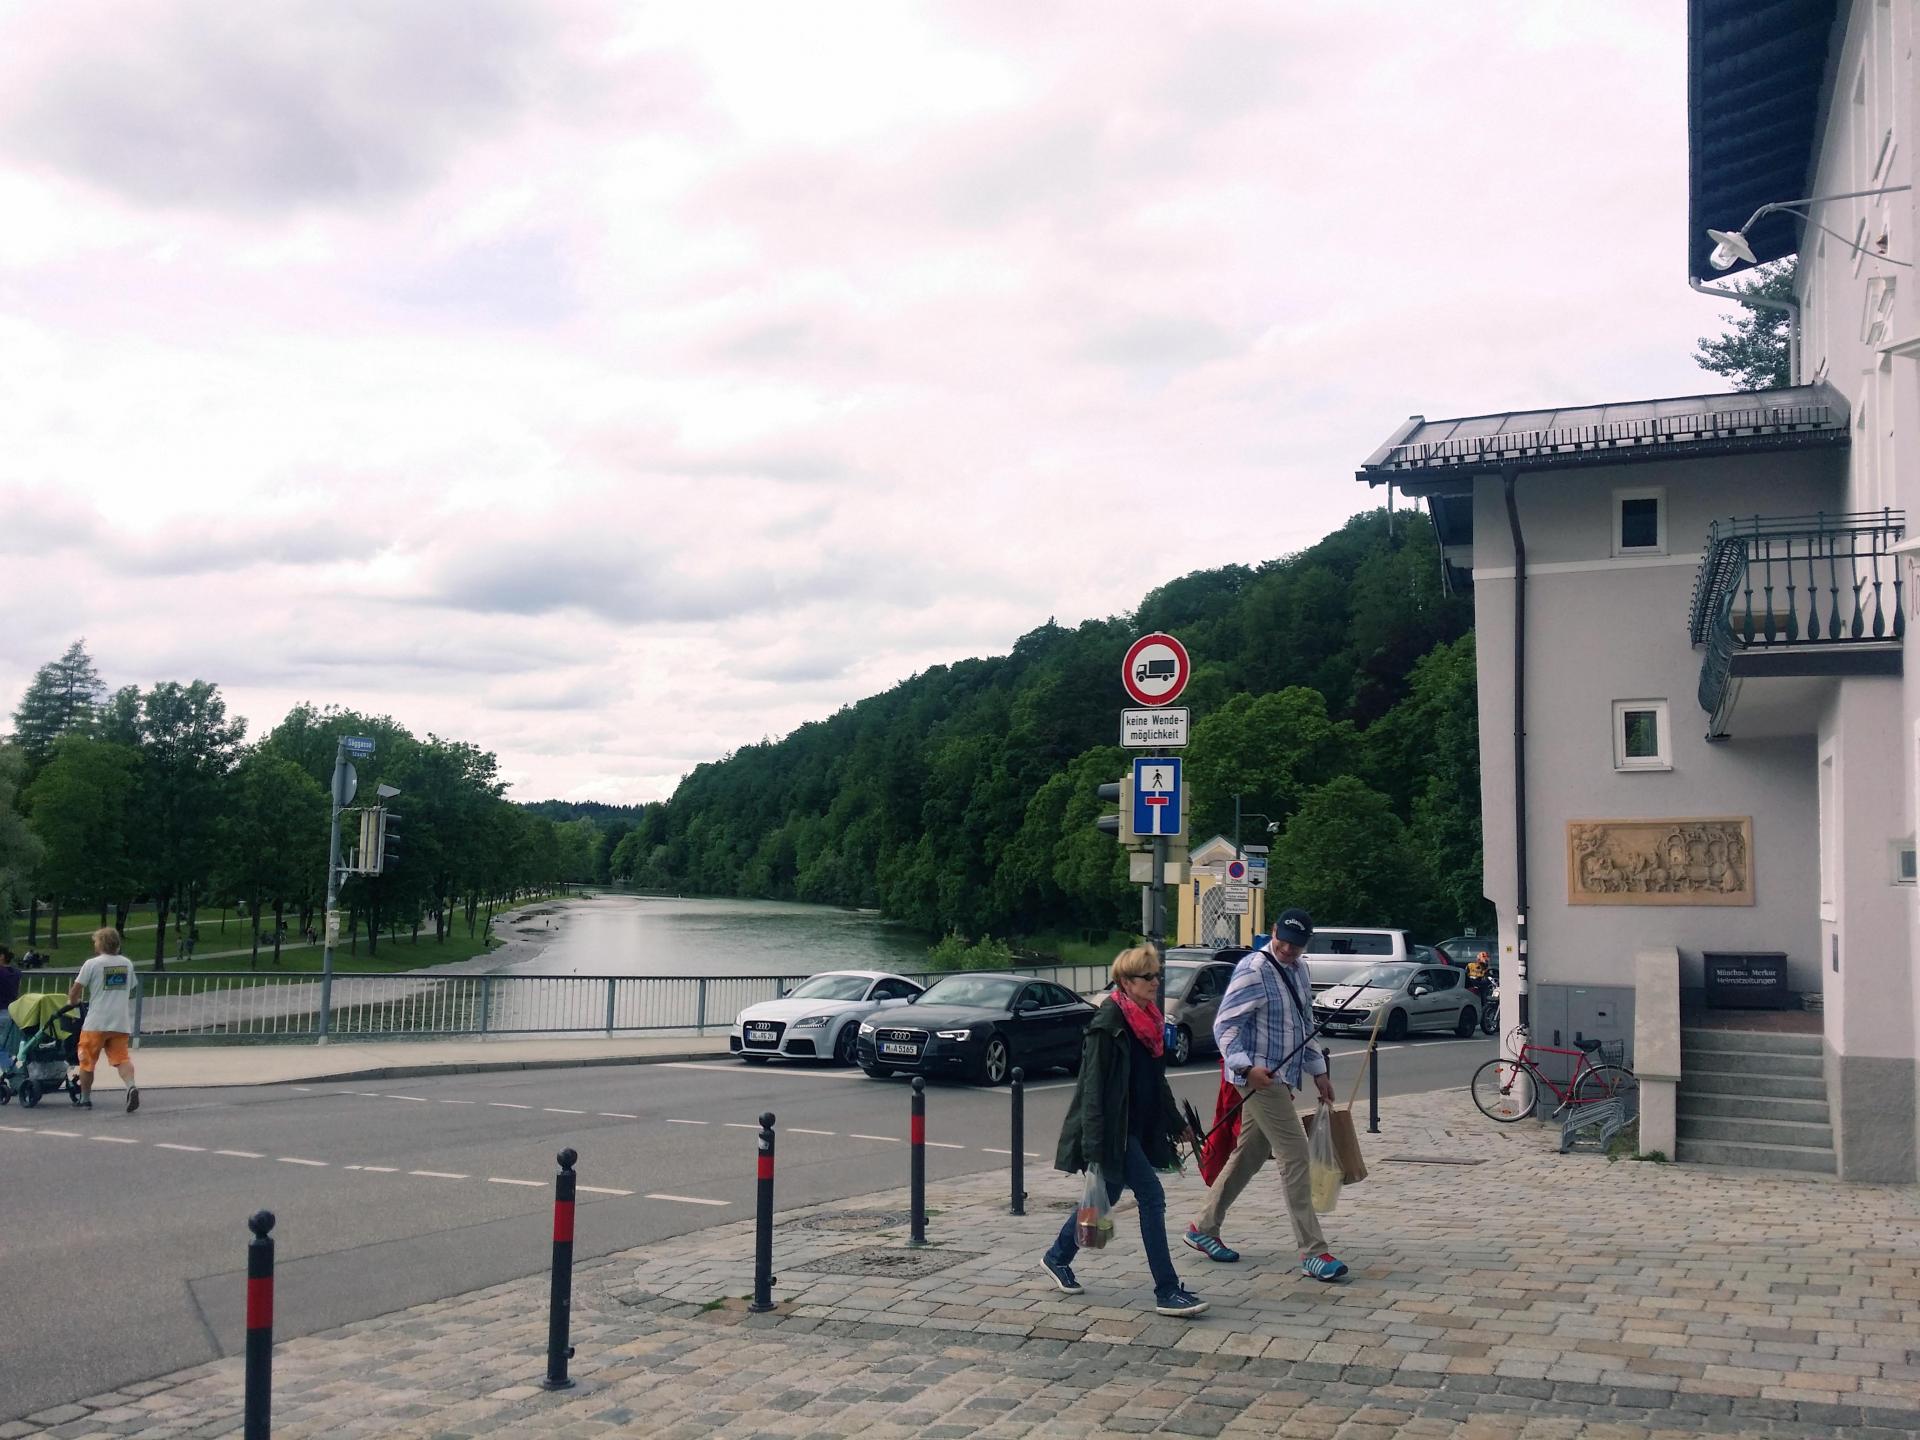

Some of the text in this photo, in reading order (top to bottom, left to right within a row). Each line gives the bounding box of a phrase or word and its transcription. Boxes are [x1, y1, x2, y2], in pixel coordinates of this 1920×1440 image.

[1126, 714, 1184, 726] keine Wende-
[1130, 729, 1179, 742] möglichkeit
